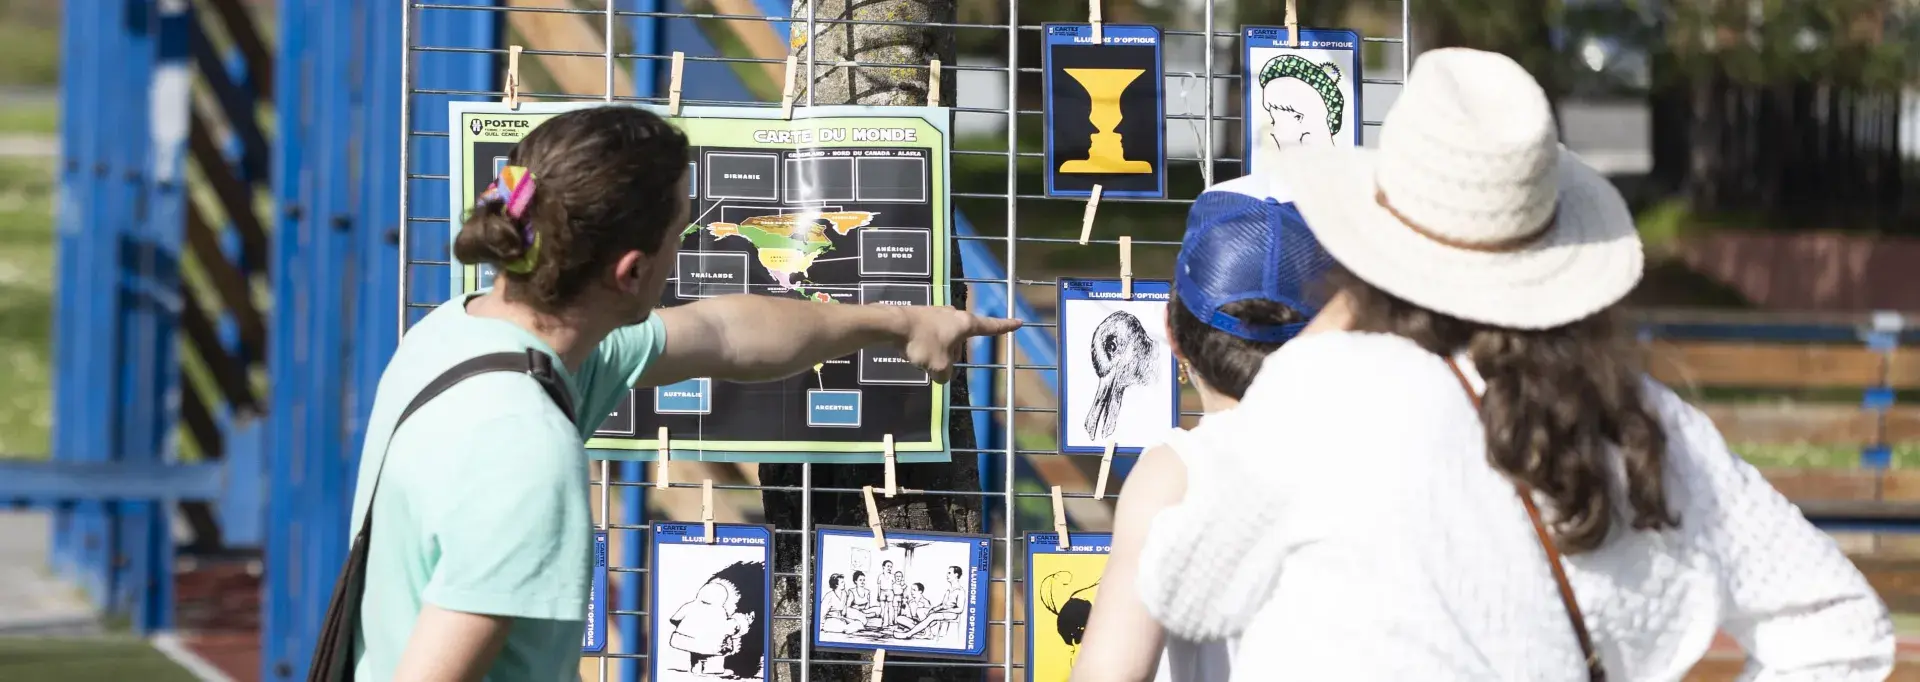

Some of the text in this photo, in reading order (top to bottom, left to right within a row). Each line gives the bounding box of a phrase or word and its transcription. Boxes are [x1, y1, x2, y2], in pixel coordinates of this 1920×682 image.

[484, 119, 530, 128] POSTER
[752, 127, 918, 145] CARTE DU MONDE
[967, 566, 978, 650] ILLUSIONS D'OPTIQUE
[587, 603, 595, 647] D'OPTIQUE
